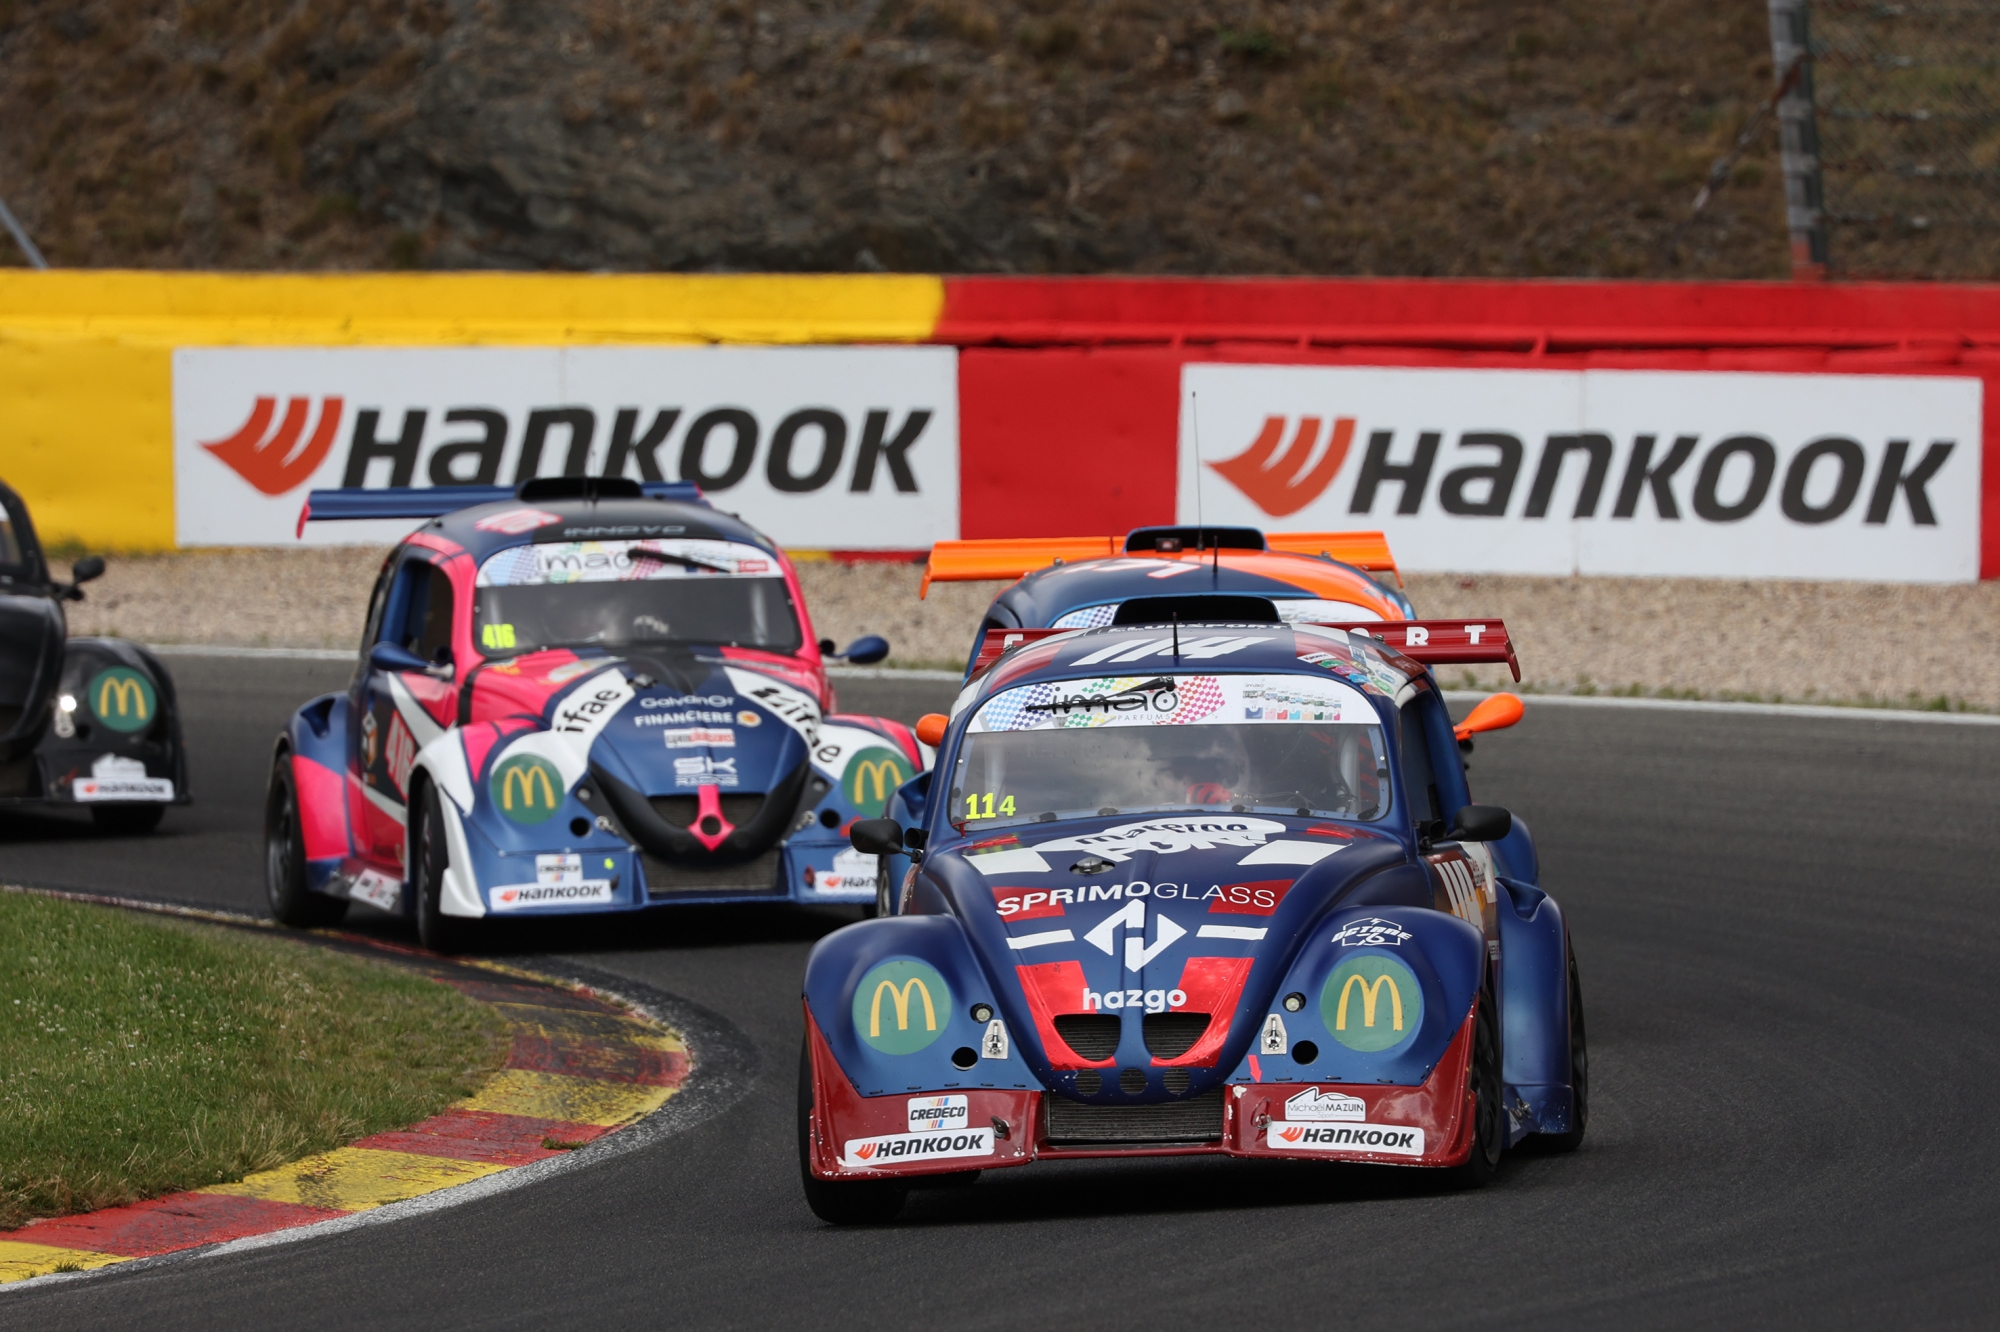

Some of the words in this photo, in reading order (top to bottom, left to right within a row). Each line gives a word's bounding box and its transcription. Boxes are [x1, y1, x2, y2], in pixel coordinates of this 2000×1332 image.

[482, 623, 516, 649] 416
[1068, 636, 1278, 667] 114
[634, 710, 733, 728] FINANCIERE
[1117, 713, 1171, 722] PARFUMS
[965, 792, 1017, 819] 114
[1331, 925, 1413, 943] OCTANE
[1082, 987, 1187, 1013] hazgo
[910, 1106, 966, 1121] CREDECO
